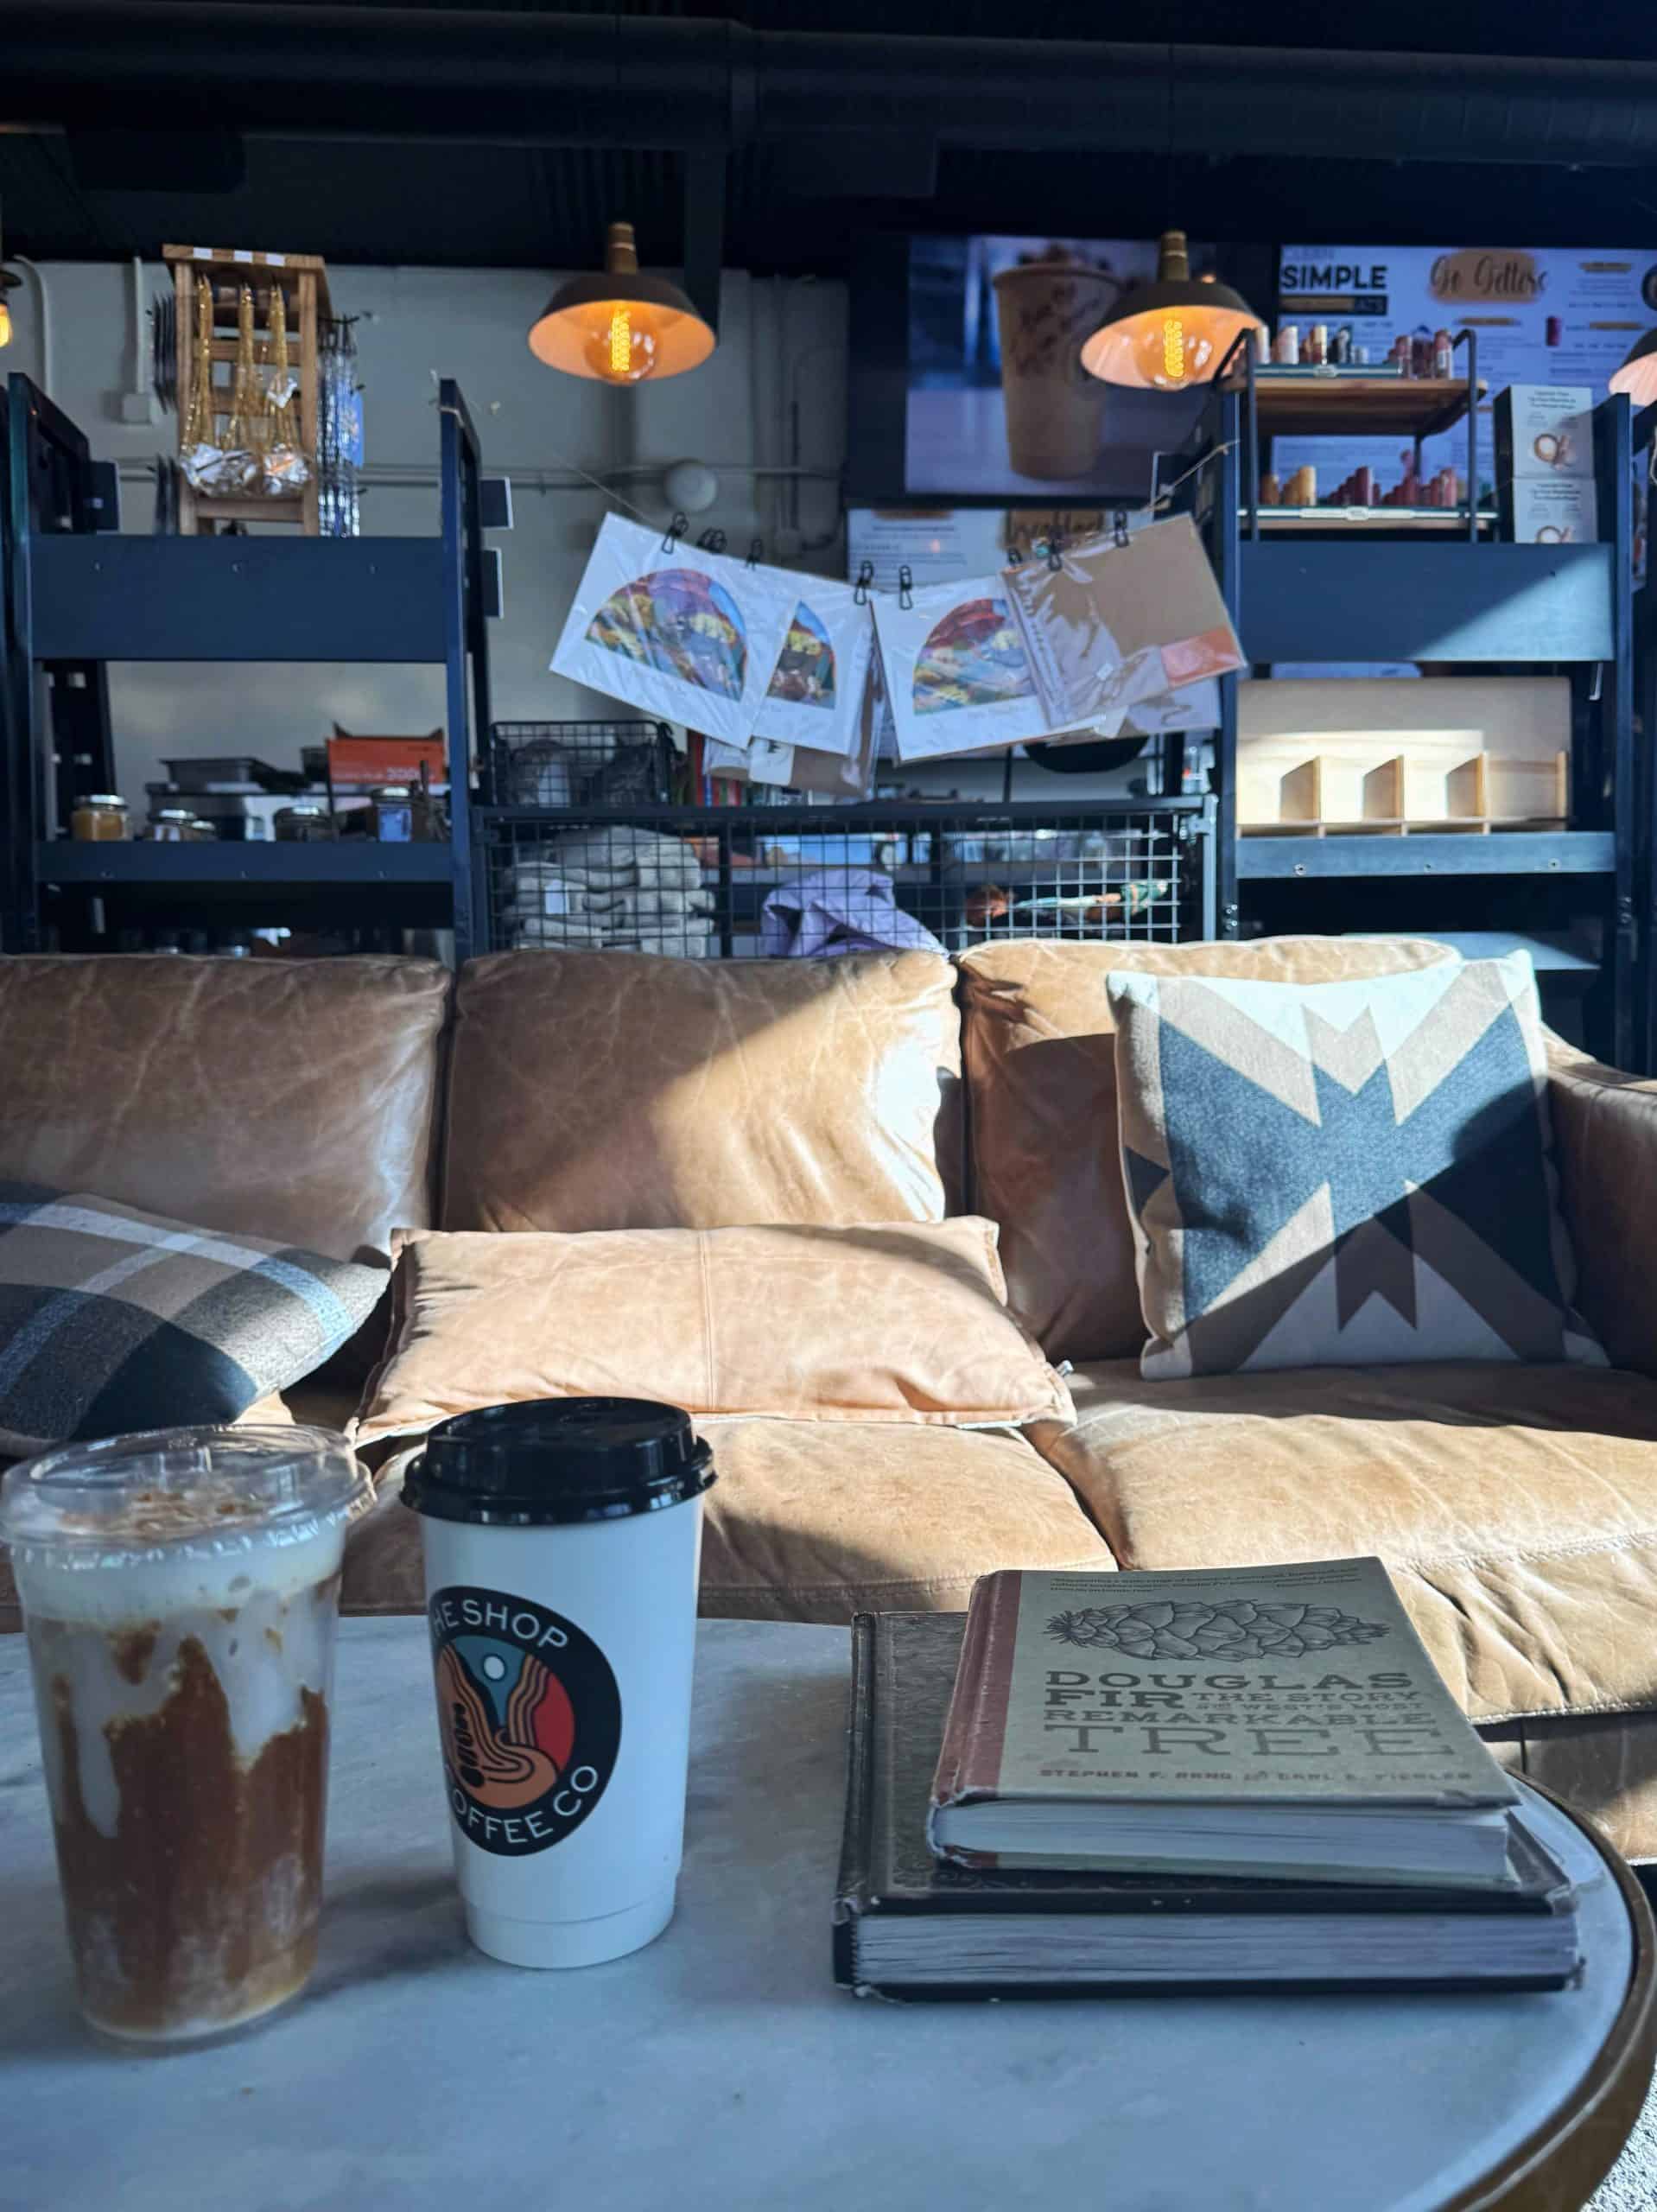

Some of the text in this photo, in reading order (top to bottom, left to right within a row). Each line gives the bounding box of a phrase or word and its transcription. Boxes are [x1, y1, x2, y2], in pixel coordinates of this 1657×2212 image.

[1282, 264, 1387, 289] SIMPLE
[462, 1599, 568, 1648] SHOP
[1045, 1671, 1413, 1690] DOUGLAS
[1044, 1688, 1184, 1709] FIR
[1190, 1693, 1274, 1701] THE
[1287, 1691, 1420, 1702] STORY
[1044, 1709, 1437, 1726] REMARKABLE
[1044, 1725, 1455, 1756] TREE
[448, 1766, 598, 1843] OFFEE CO
